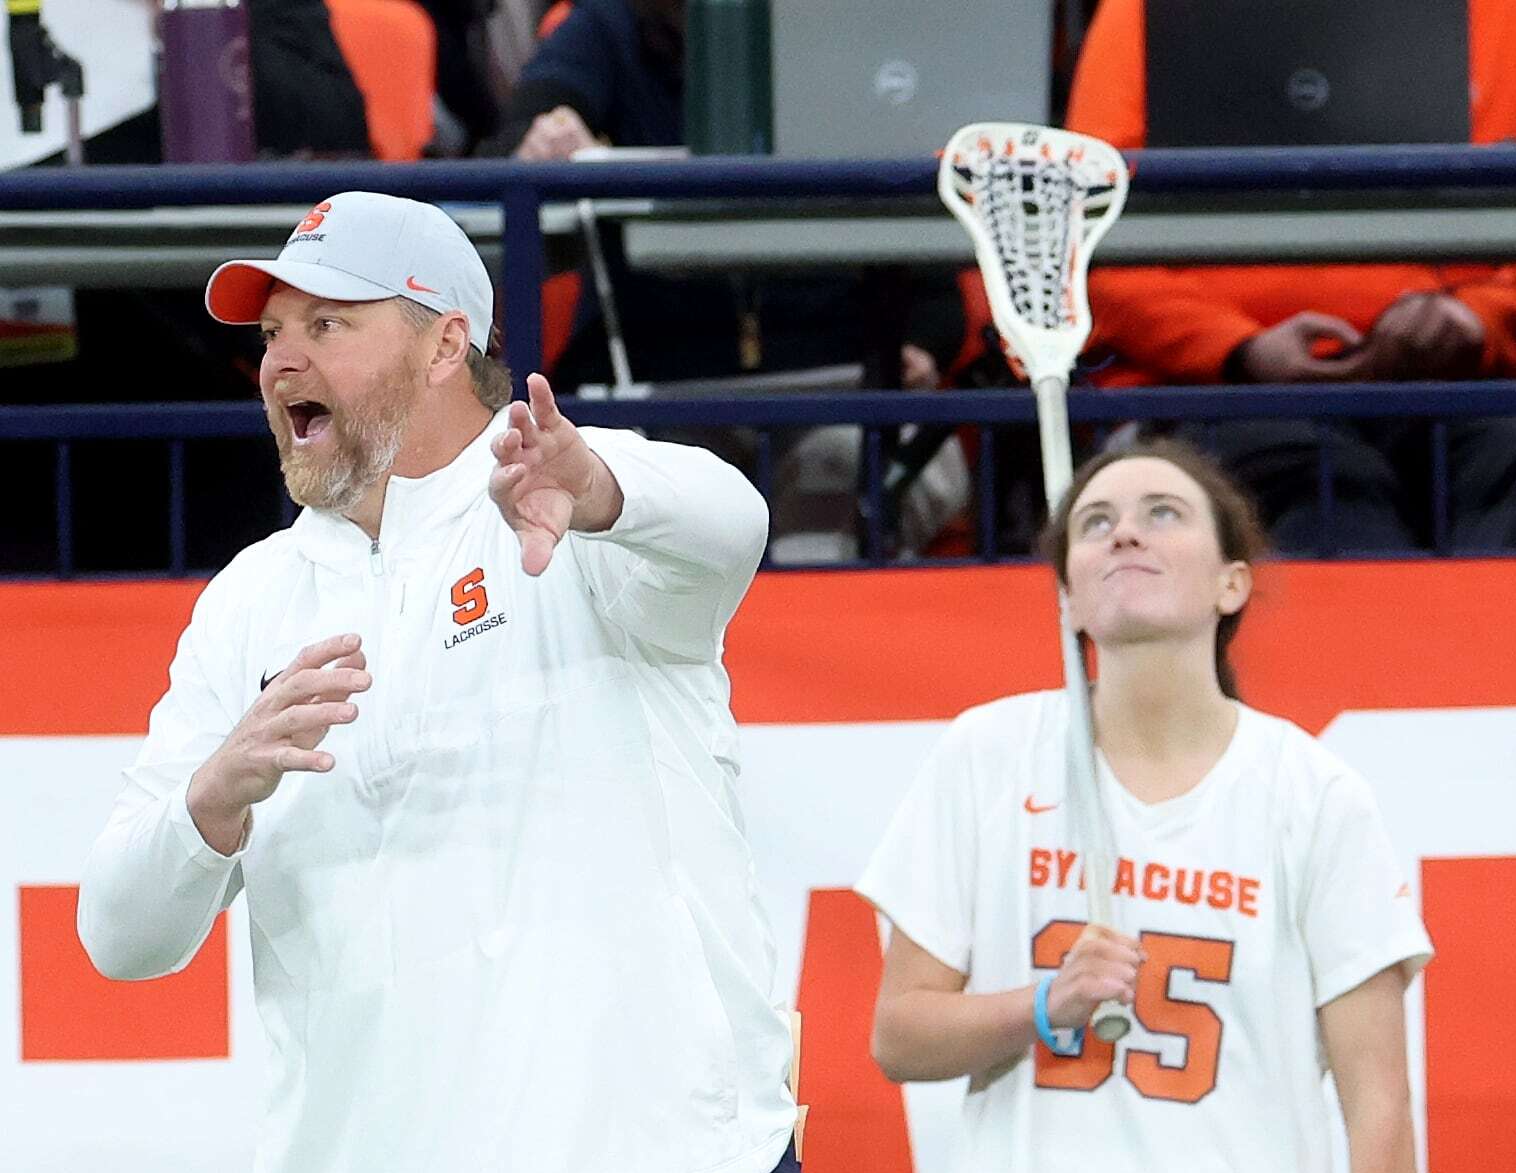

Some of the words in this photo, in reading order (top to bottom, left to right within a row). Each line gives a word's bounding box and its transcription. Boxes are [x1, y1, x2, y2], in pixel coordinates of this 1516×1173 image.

[450, 567, 488, 625] S
[444, 612, 507, 649] LACROSSE
[1029, 848, 1261, 917] SYACUSE
